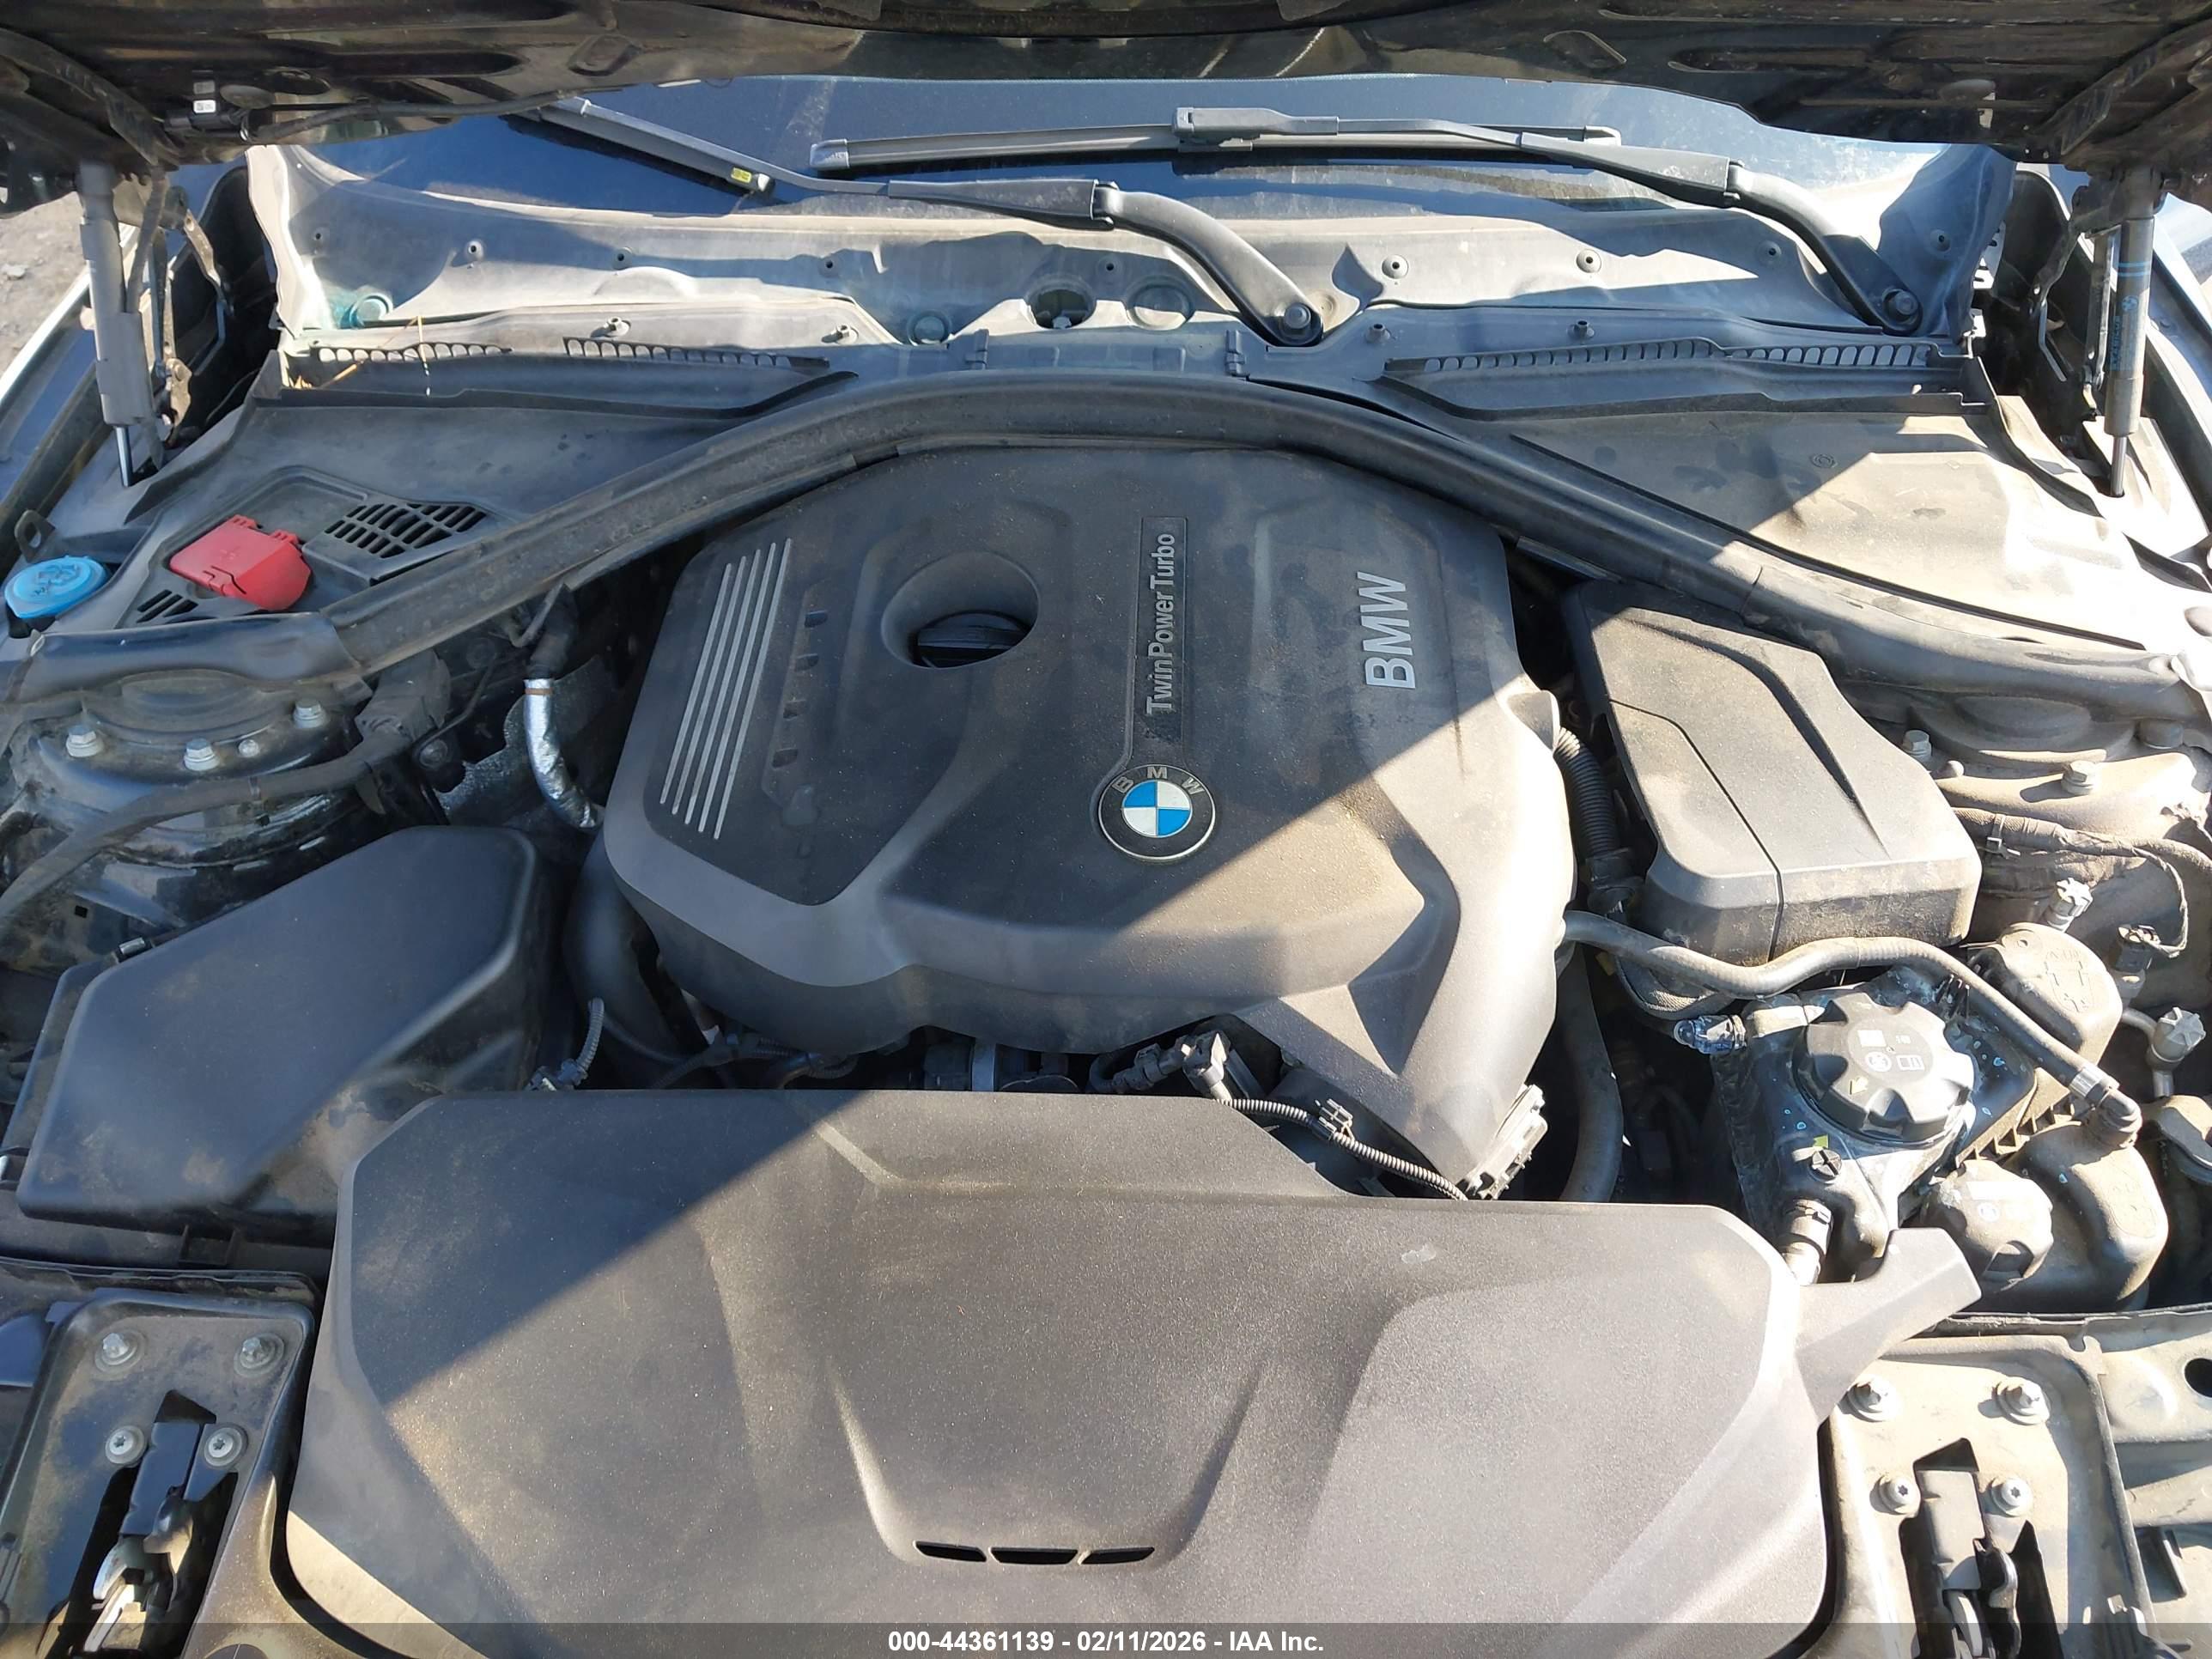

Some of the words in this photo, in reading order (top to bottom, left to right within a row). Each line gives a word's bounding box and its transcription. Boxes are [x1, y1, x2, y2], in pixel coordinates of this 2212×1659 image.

[1150, 533, 1176, 590] Turbo
[1146, 592, 1175, 715] TwinPower
[1357, 571, 1416, 689] BMW
[1111, 766, 1206, 795] BMW
